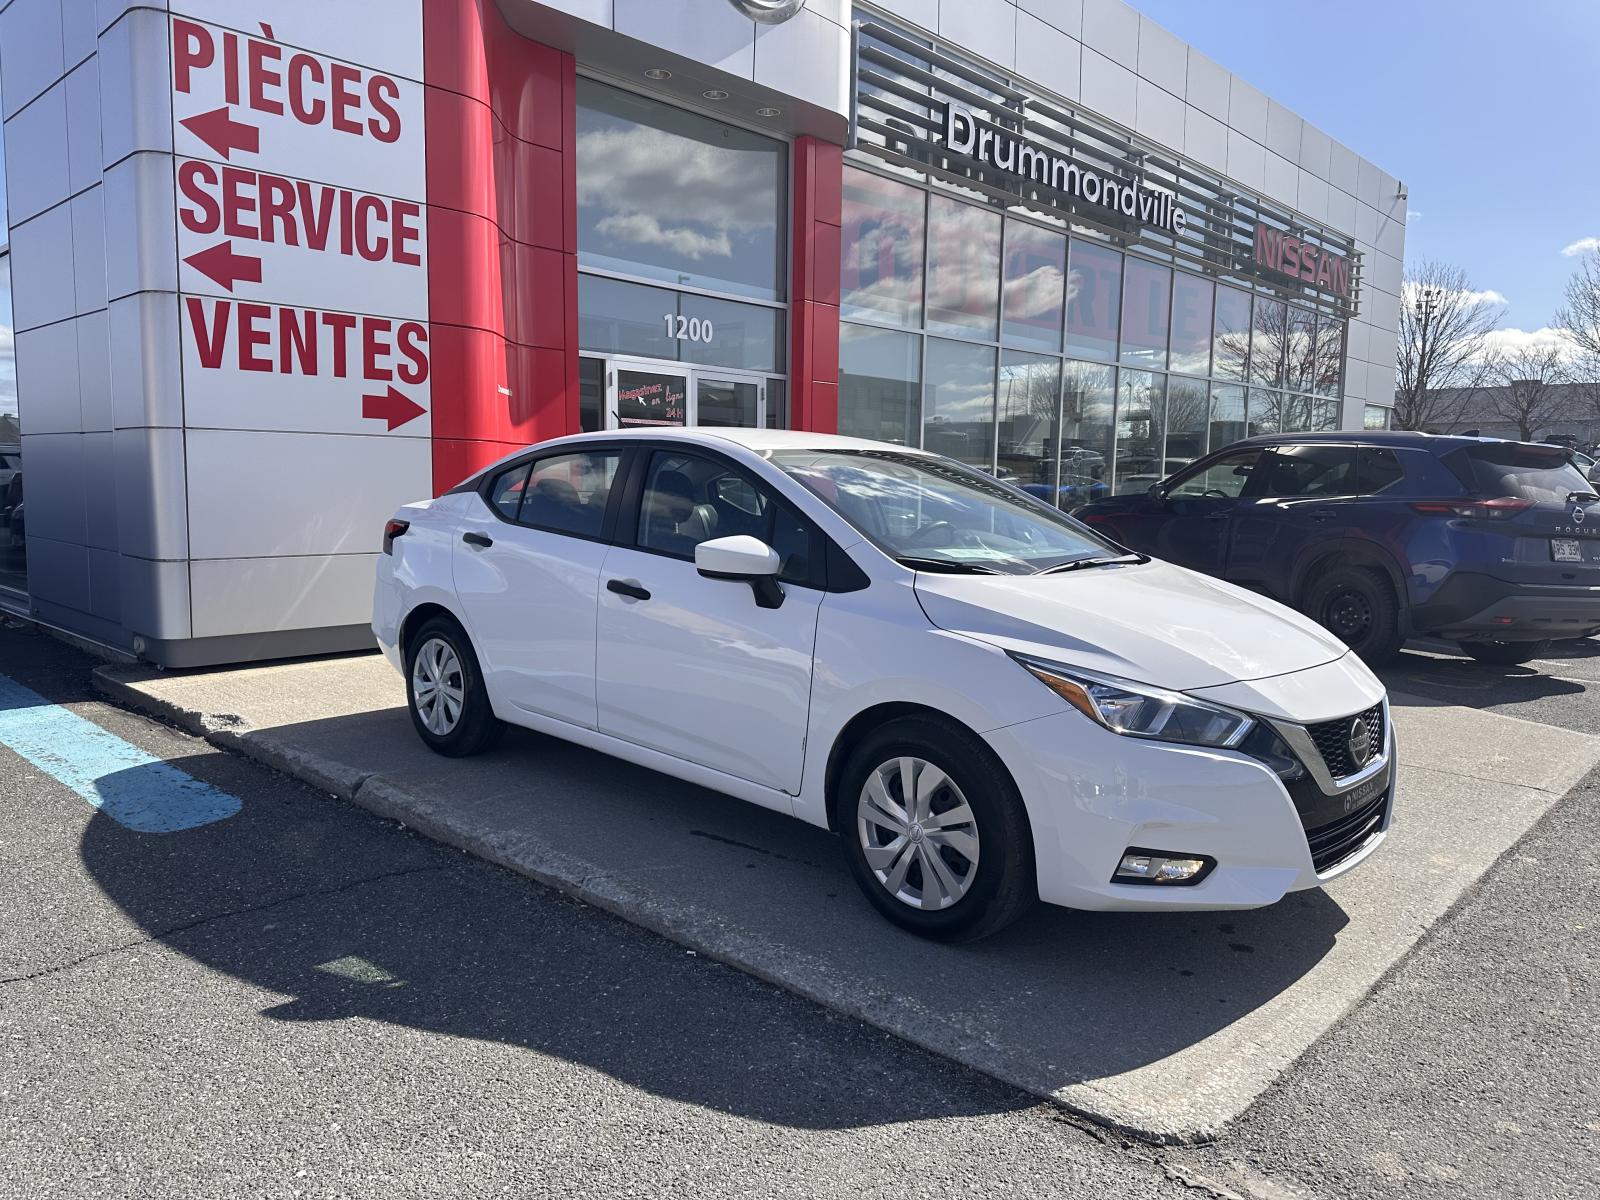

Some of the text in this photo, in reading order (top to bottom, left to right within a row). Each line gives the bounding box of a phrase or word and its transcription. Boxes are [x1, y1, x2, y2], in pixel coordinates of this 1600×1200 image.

[173, 18, 402, 143] PIÈCES
[178, 160, 421, 267] SERVICE
[947, 102, 1187, 236] Drummondville
[1256, 223, 1350, 297] NISSAN
[186, 297, 430, 385] VENTES
[664, 313, 713, 343] 1200
